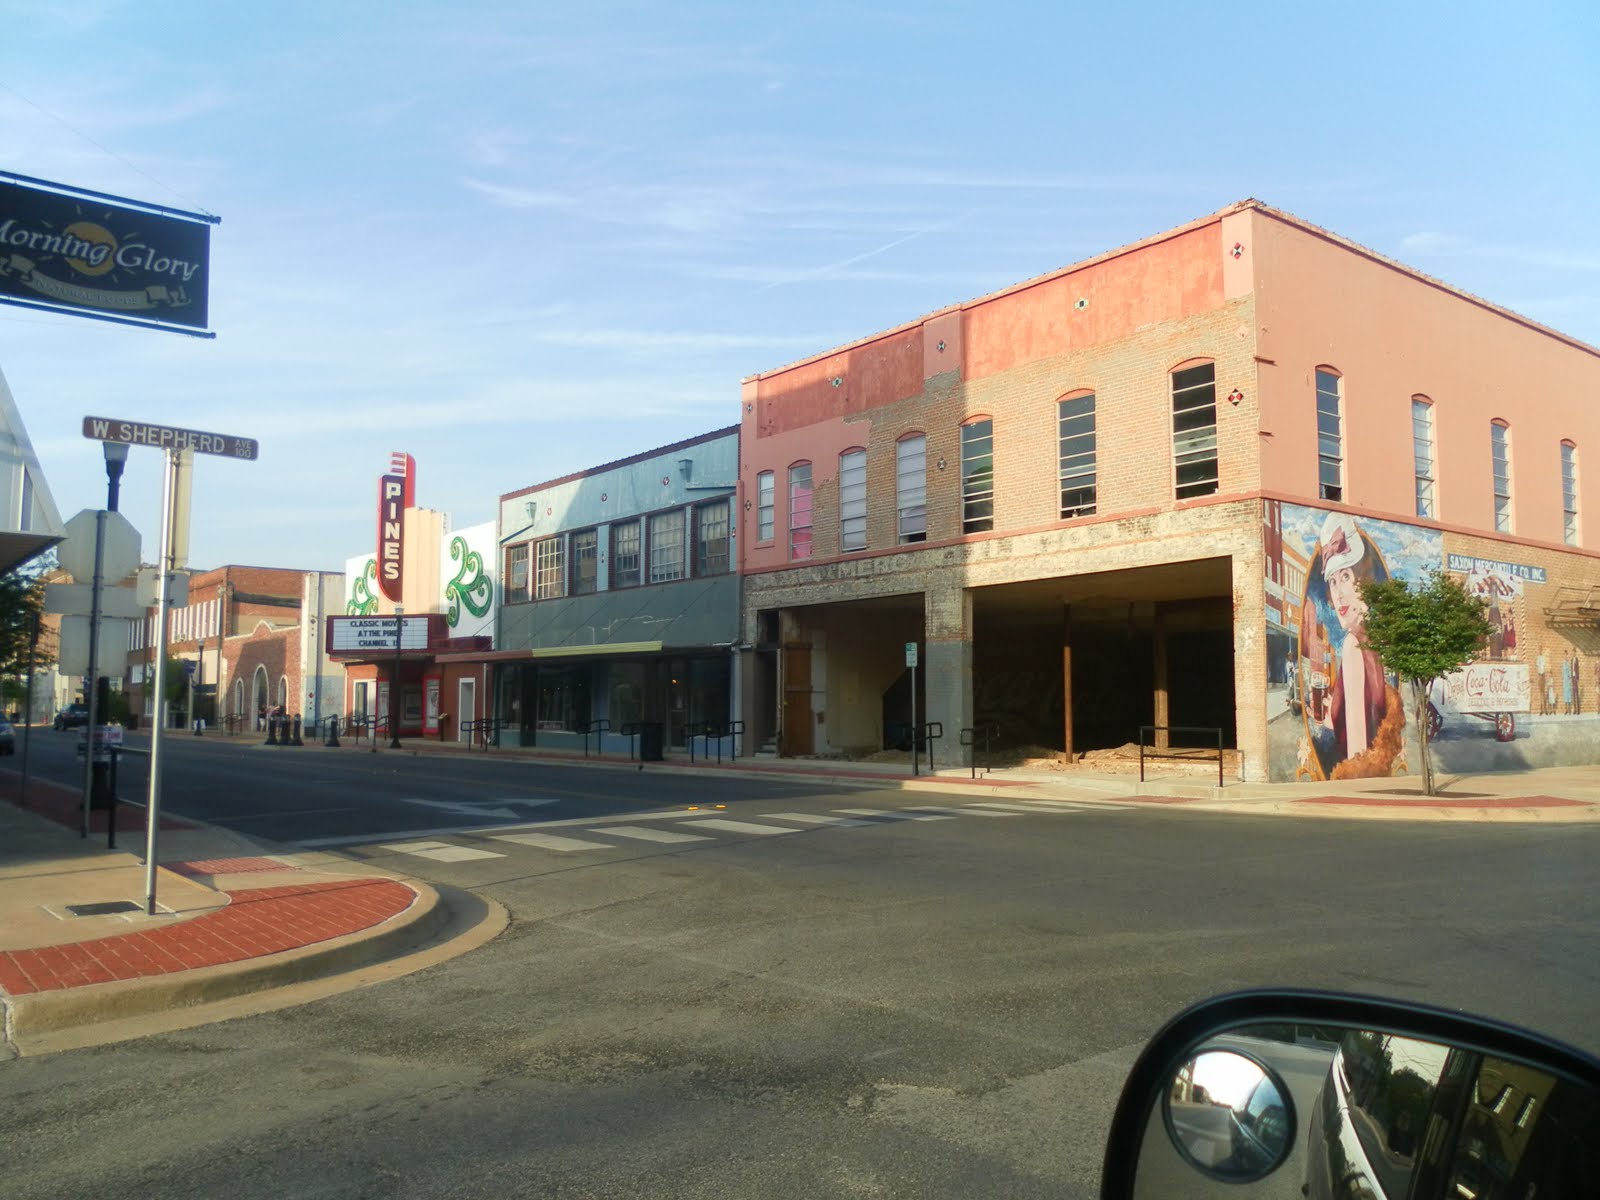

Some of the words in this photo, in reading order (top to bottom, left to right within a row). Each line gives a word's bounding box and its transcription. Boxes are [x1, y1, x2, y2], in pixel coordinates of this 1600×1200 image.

[116, 243, 200, 281] Glory
[93, 420, 113, 439] W.
[119, 424, 225, 453] SHEPHERD
[235, 439, 252, 449] AVE
[235, 448, 251, 458] 100
[384, 481, 402, 580] PINES
[1449, 555, 1474, 569] SAXON
